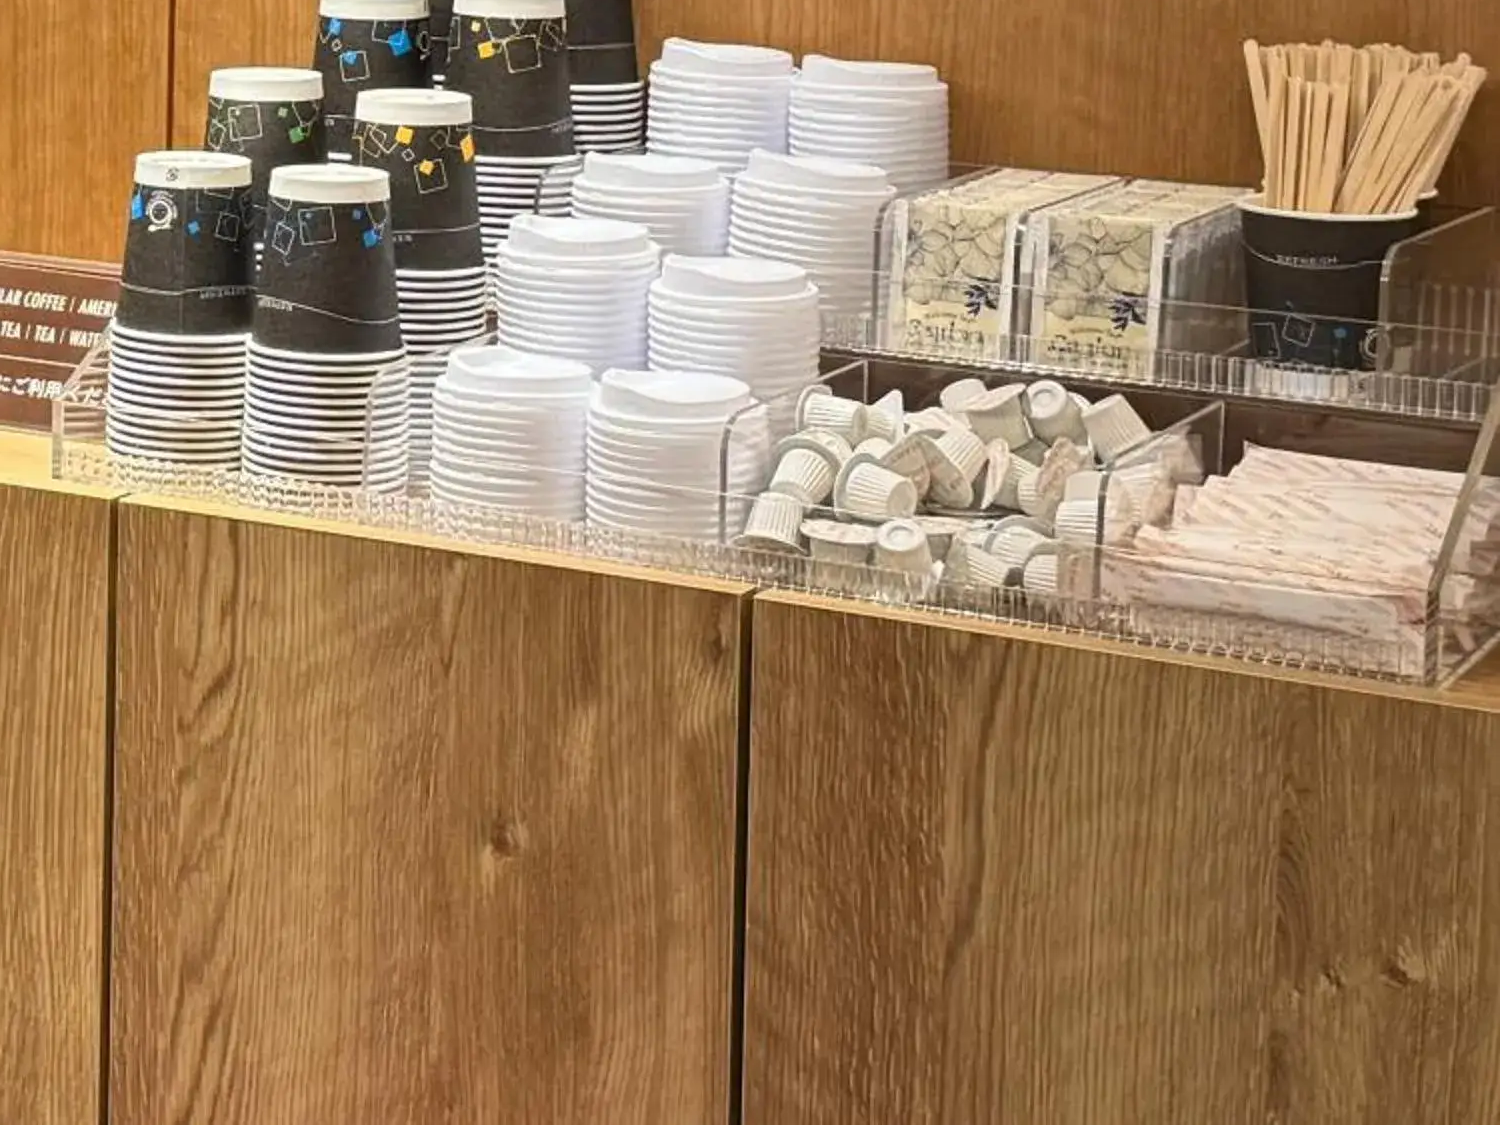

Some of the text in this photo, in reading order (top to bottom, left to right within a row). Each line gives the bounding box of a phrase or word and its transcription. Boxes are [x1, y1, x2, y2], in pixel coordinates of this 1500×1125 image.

[23, 290, 68, 312] COFFEE
[1, 320, 22, 340] TEA
[34, 324, 56, 344] TEA
